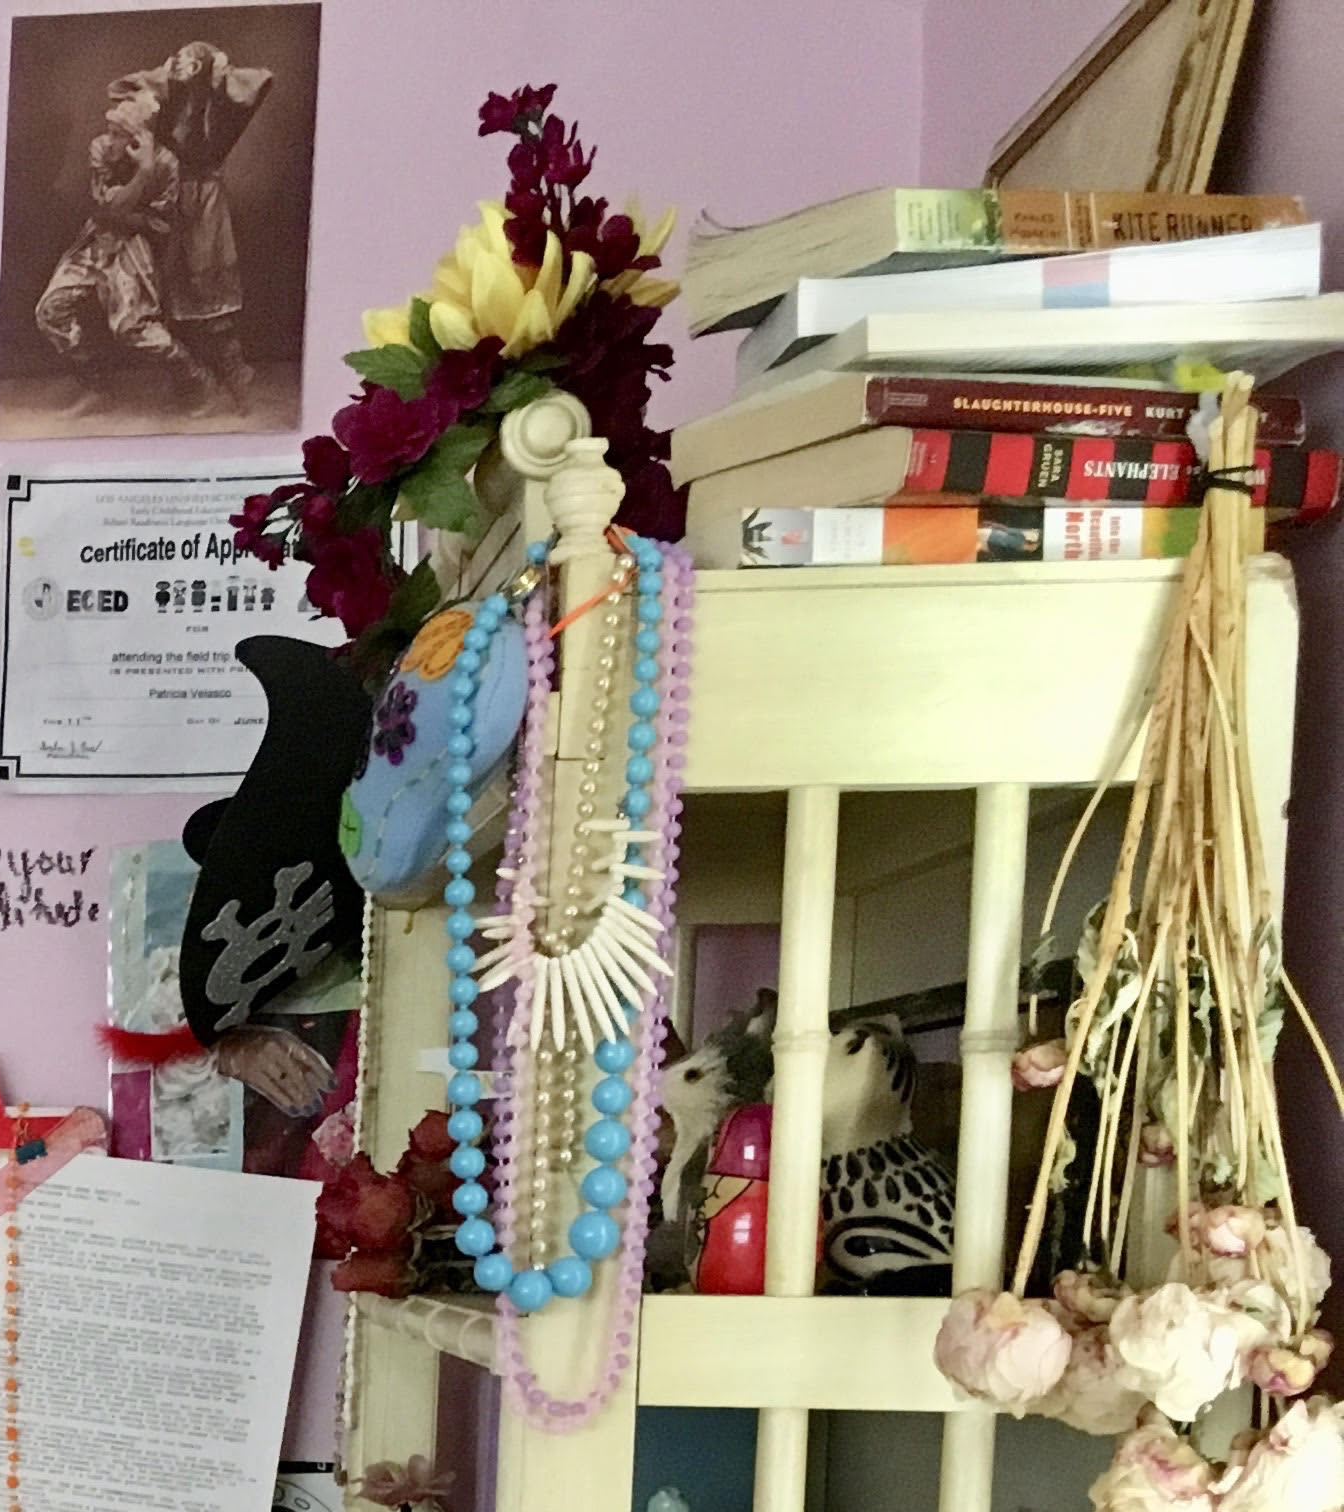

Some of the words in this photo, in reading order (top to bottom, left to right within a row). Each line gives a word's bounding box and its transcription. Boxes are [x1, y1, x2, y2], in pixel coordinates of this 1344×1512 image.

[1113, 212, 1160, 243] KITE
[952, 397, 1133, 419] SLAUGHTERHOUSE-FIVE
[1145, 406, 1185, 421] KURT
[1038, 443, 1052, 489] GRUEN
[1053, 448, 1066, 483] SARA
[1083, 459, 1181, 481] ELEPHANTS
[79, 536, 176, 564] Certificate
[180, 532, 202, 560] of
[1064, 511, 1082, 559] North
[111, 651, 163, 664] attending
[165, 651, 184, 663] the
[186, 650, 210, 663] field
[212, 651, 231, 664] trip
[148, 688, 188, 699] Patricia
[6, 845, 97, 903] your
